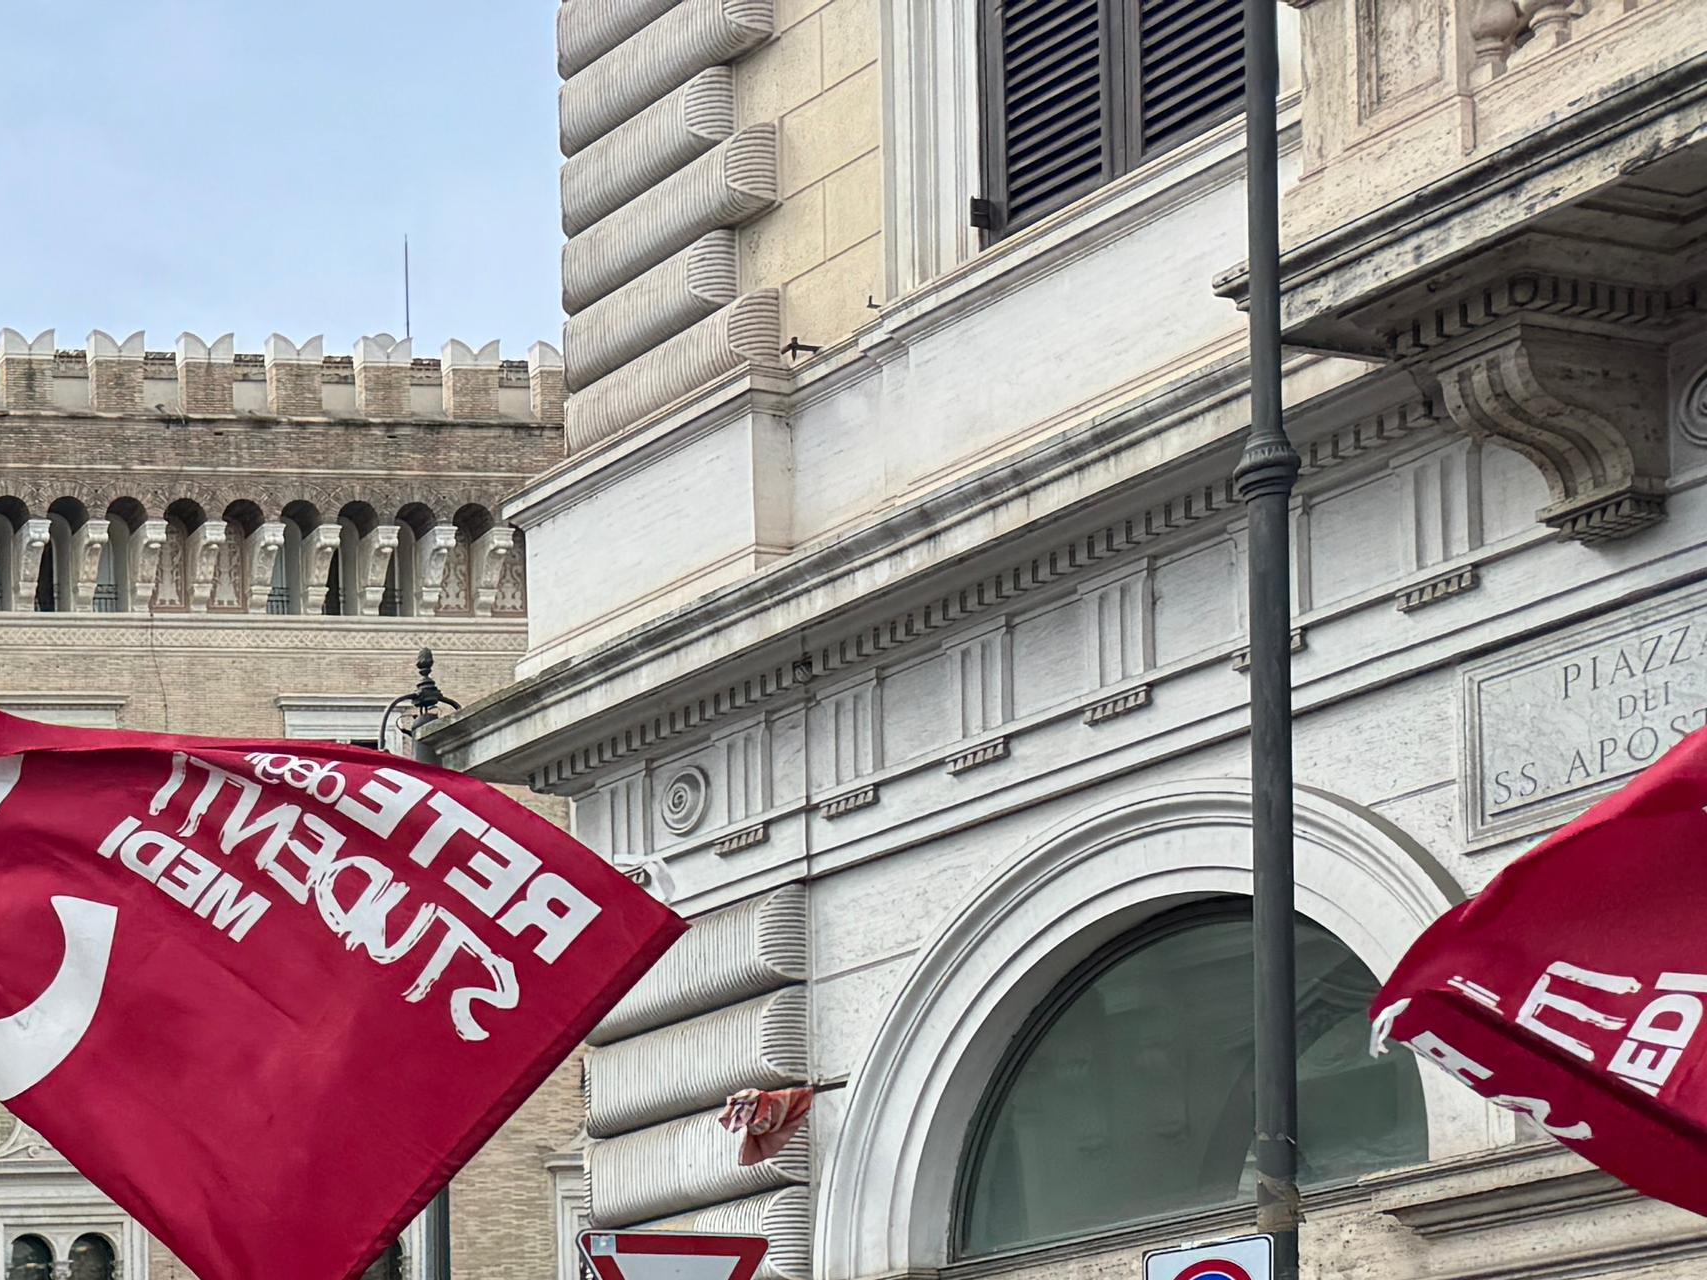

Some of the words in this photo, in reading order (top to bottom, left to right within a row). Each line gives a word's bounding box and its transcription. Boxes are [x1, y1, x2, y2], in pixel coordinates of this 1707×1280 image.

[1562, 624, 1707, 701] PIAZZ
[1617, 680, 1672, 721] DEI
[1493, 761, 1552, 806] SS.
